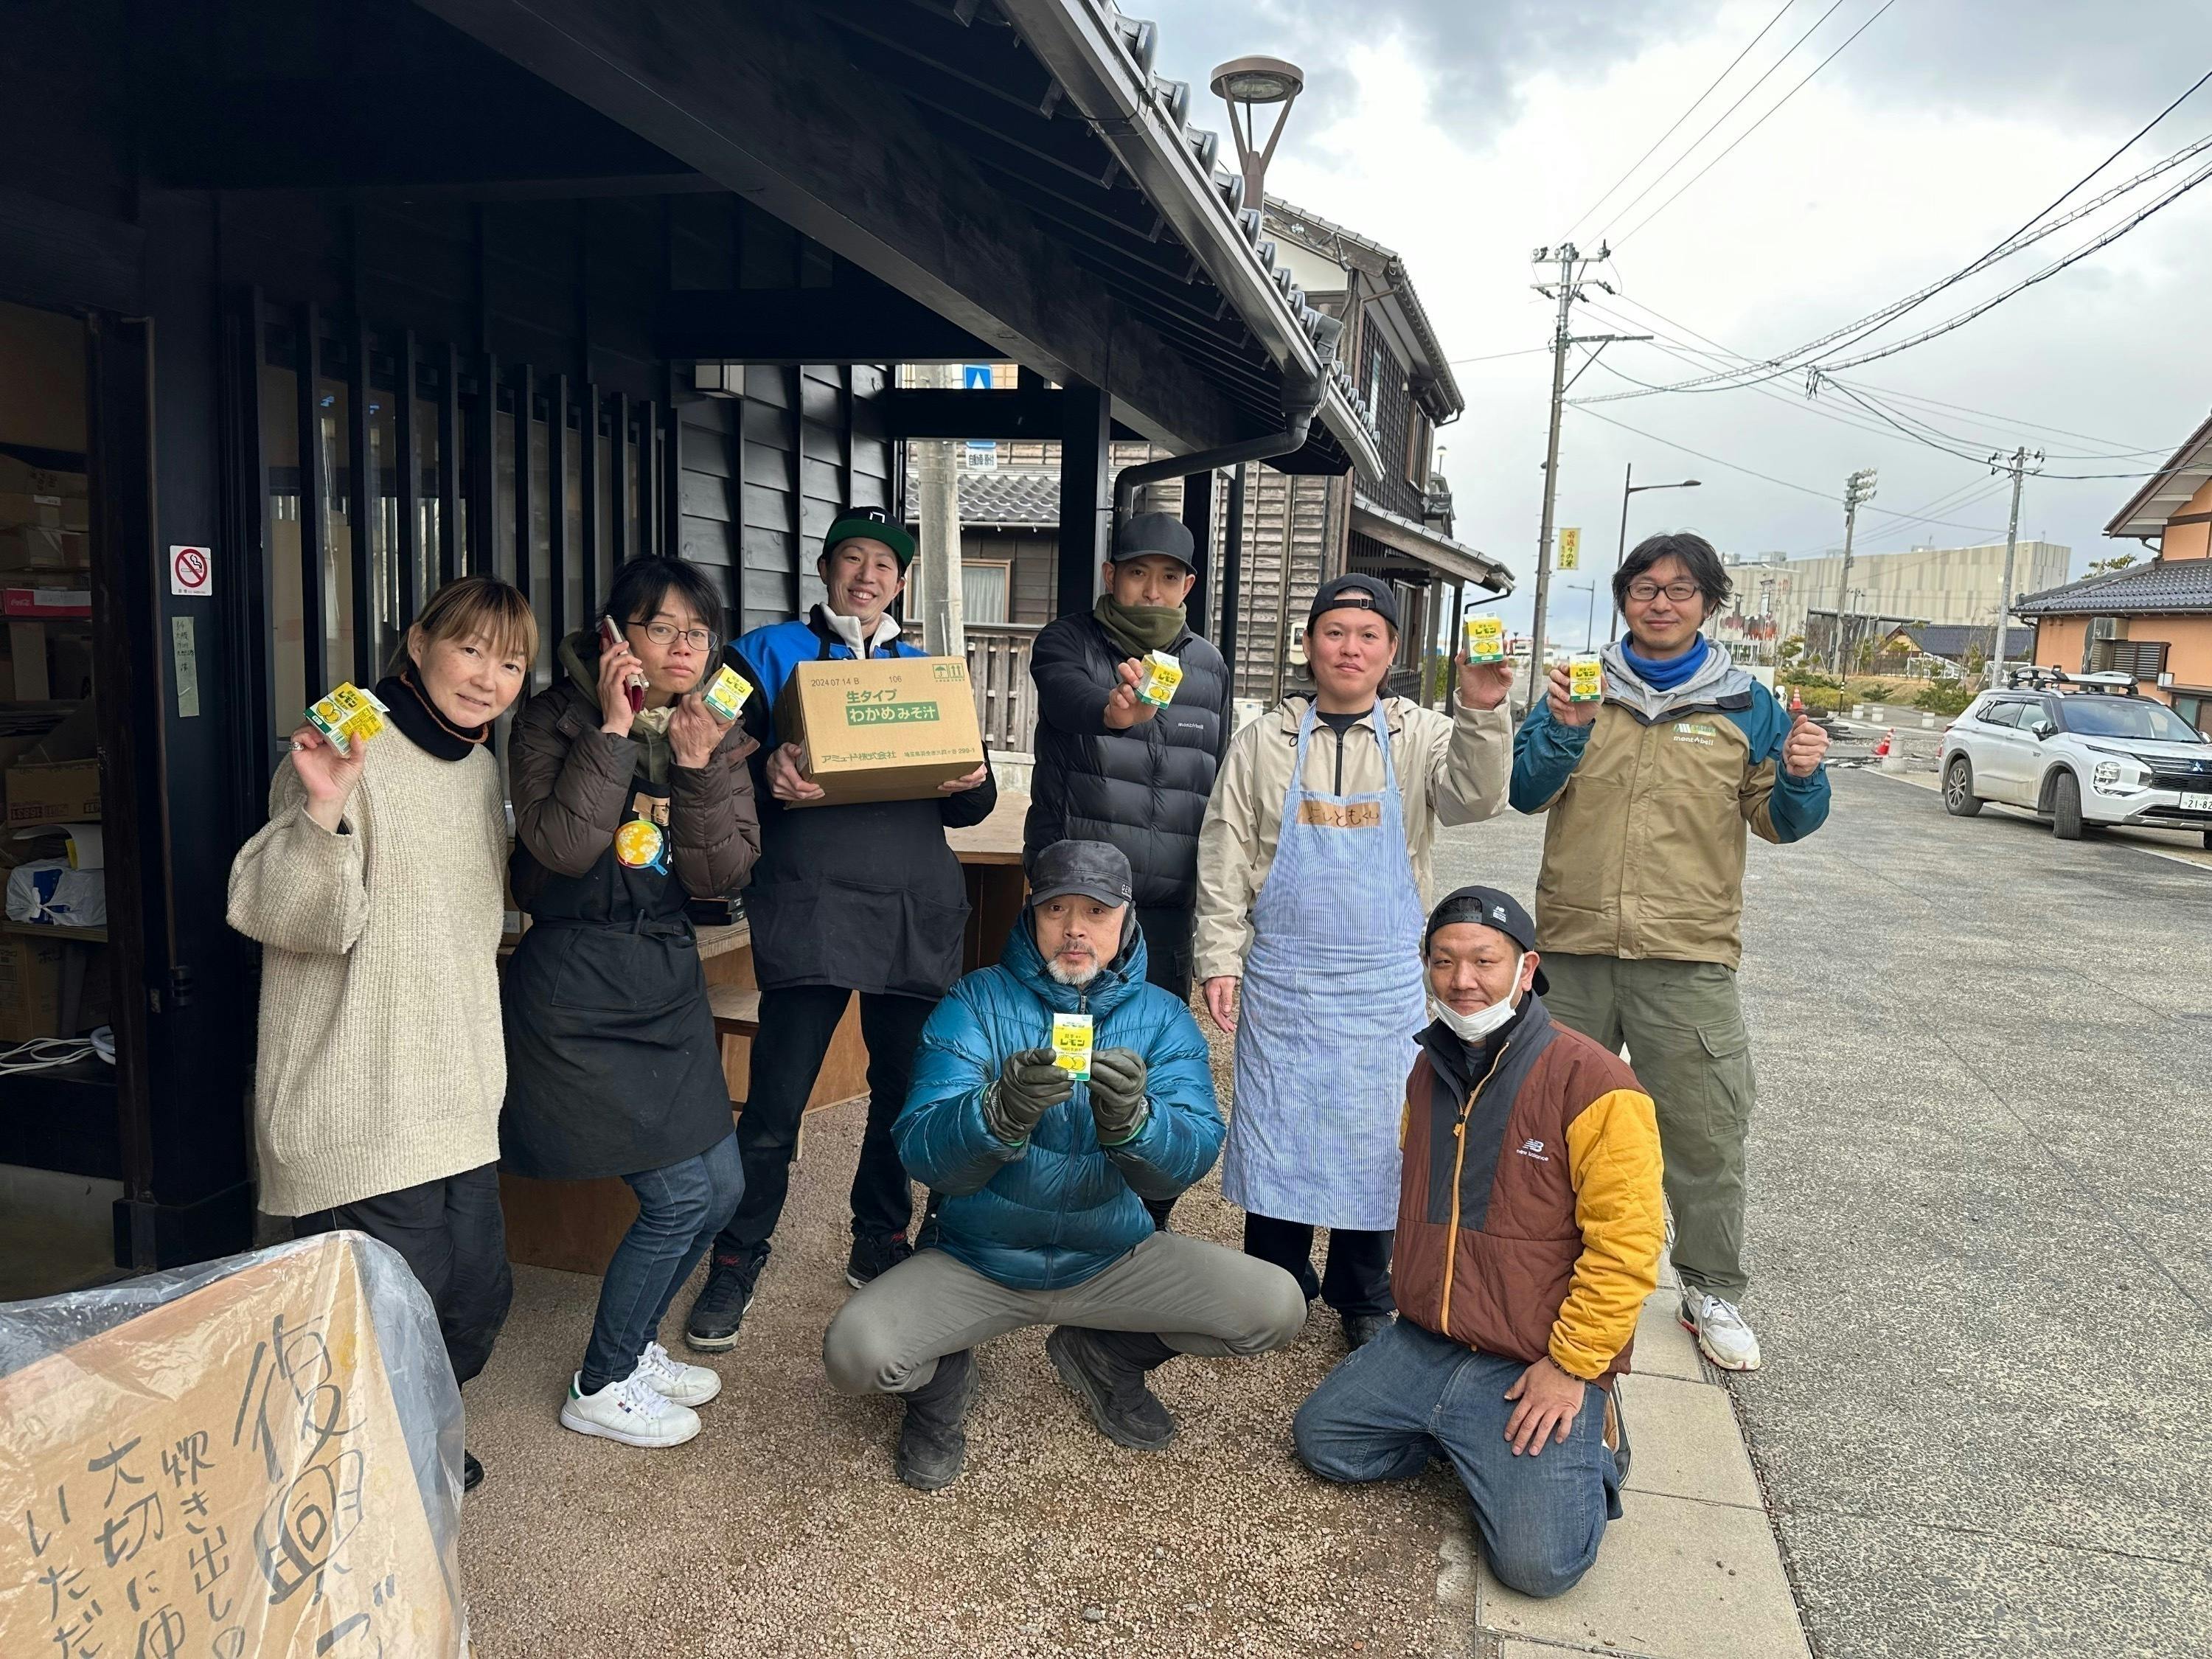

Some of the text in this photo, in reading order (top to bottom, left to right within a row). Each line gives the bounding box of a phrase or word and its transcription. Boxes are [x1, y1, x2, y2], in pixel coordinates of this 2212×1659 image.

[1475, 627, 1496, 635] レモン
[888, 675, 902, 684] 106
[846, 689, 897, 704] 生タイプ
[849, 705, 936, 723] わかめみそ汁
[821, 751, 897, 764] アミュード株式会社
[1060, 1038, 1085, 1047] レモン
